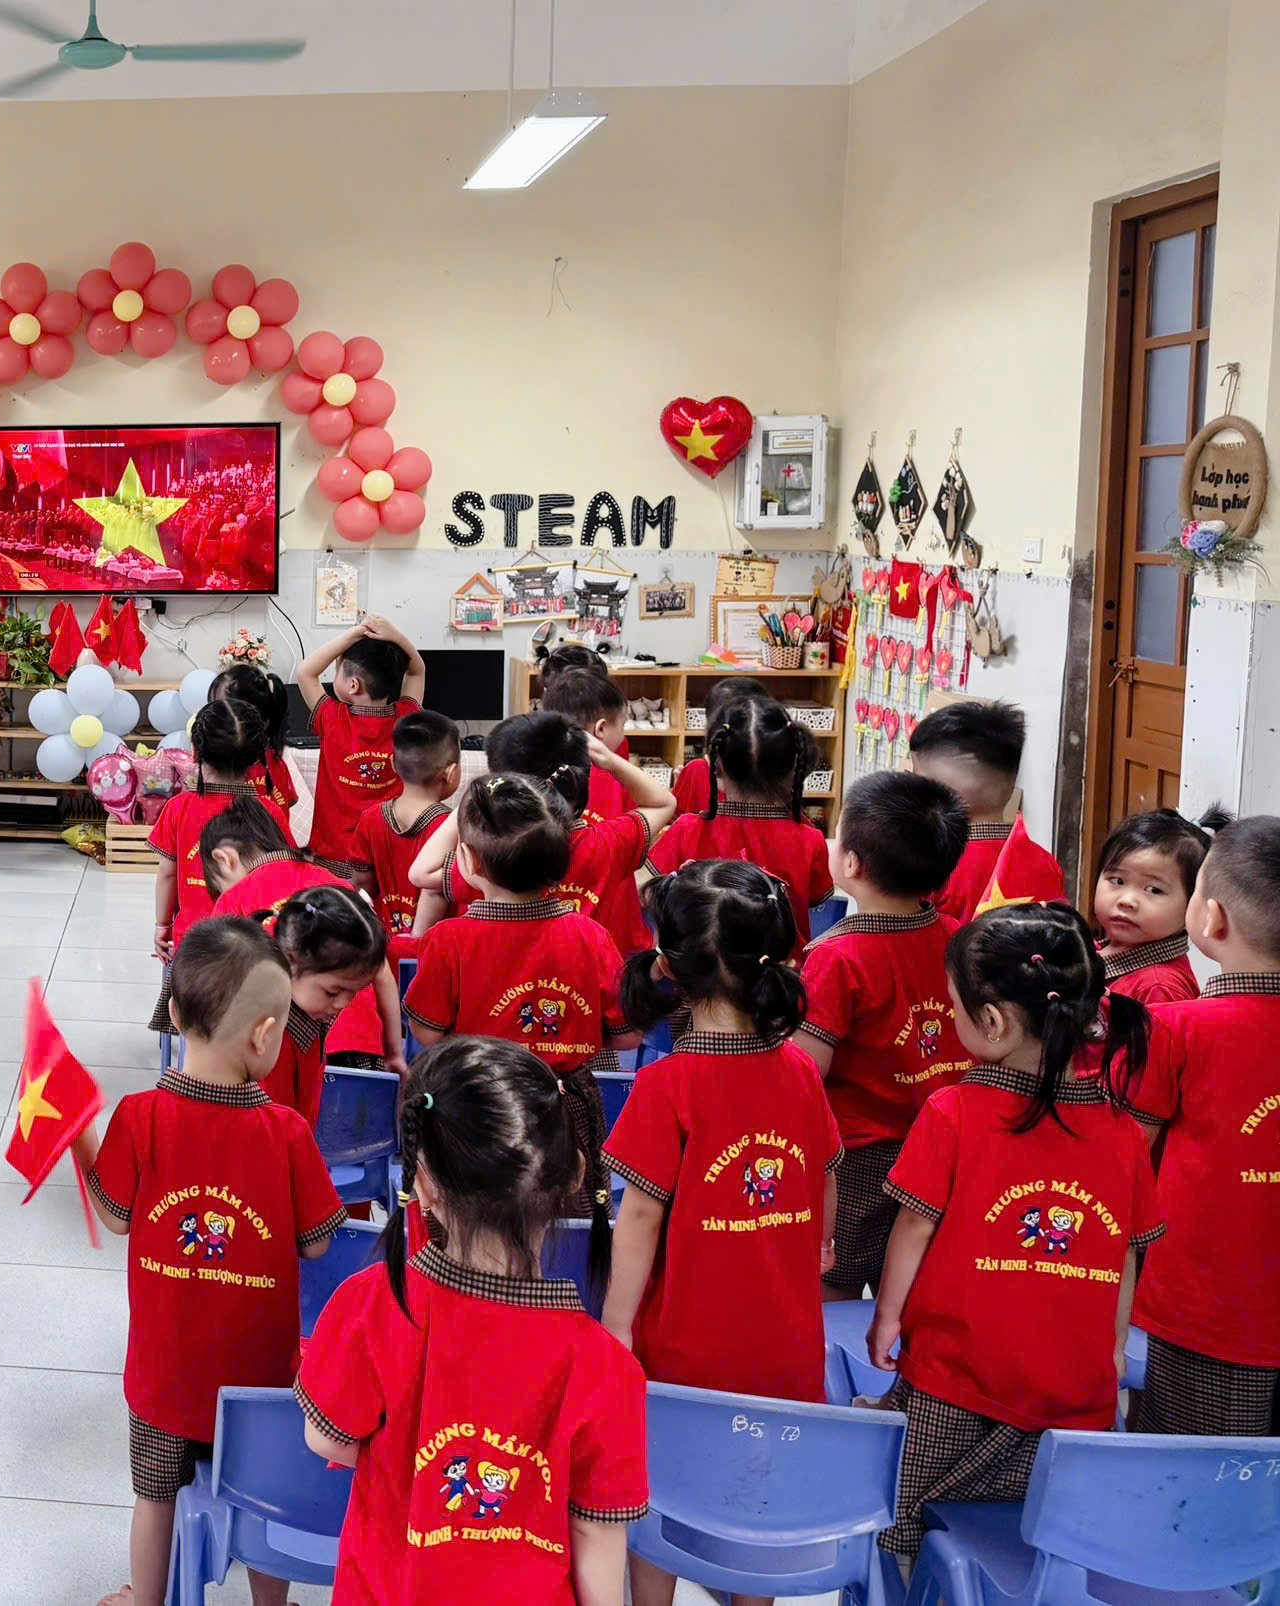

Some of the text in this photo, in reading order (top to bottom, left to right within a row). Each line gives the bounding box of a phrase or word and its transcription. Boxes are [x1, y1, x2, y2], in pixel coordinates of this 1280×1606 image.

[1200, 463, 1250, 489] Lớp học
[1192, 488, 1251, 513] hạnh phú
[444, 490, 677, 550] STEAM
[584, 889, 599, 904] NO
[489, 981, 534, 1017] TRƯỜNG
[570, 990, 592, 1017] NON
[535, 1041, 574, 1055] THƯỢNG
[1240, 1168, 1267, 1183] TÂN
[148, 1185, 272, 1240] TRƯỜNG MẦM NON
[702, 1216, 726, 1231] TÂN
[729, 1220, 756, 1232] MINH
[795, 1206, 811, 1223] PHÚ
[985, 1180, 1122, 1237] TRƯỜNG MẦM NON
[139, 1256, 161, 1272] TÂN
[162, 1264, 190, 1279] MINH
[197, 1268, 243, 1285] THƯỢNG
[244, 1274, 276, 1288] PHÚC
[975, 1256, 999, 1271] TÂN
[1000, 1259, 1027, 1271] MINH
[1034, 1260, 1087, 1279] THƯỢNG
[1088, 1268, 1121, 1284] PHÚC
[415, 1423, 552, 1503] RƯỜNG MẦM NON
[424, 1525, 453, 1547] MINH
[461, 1525, 522, 1543] THƯỢNG
[525, 1528, 564, 1553] PHÚC
